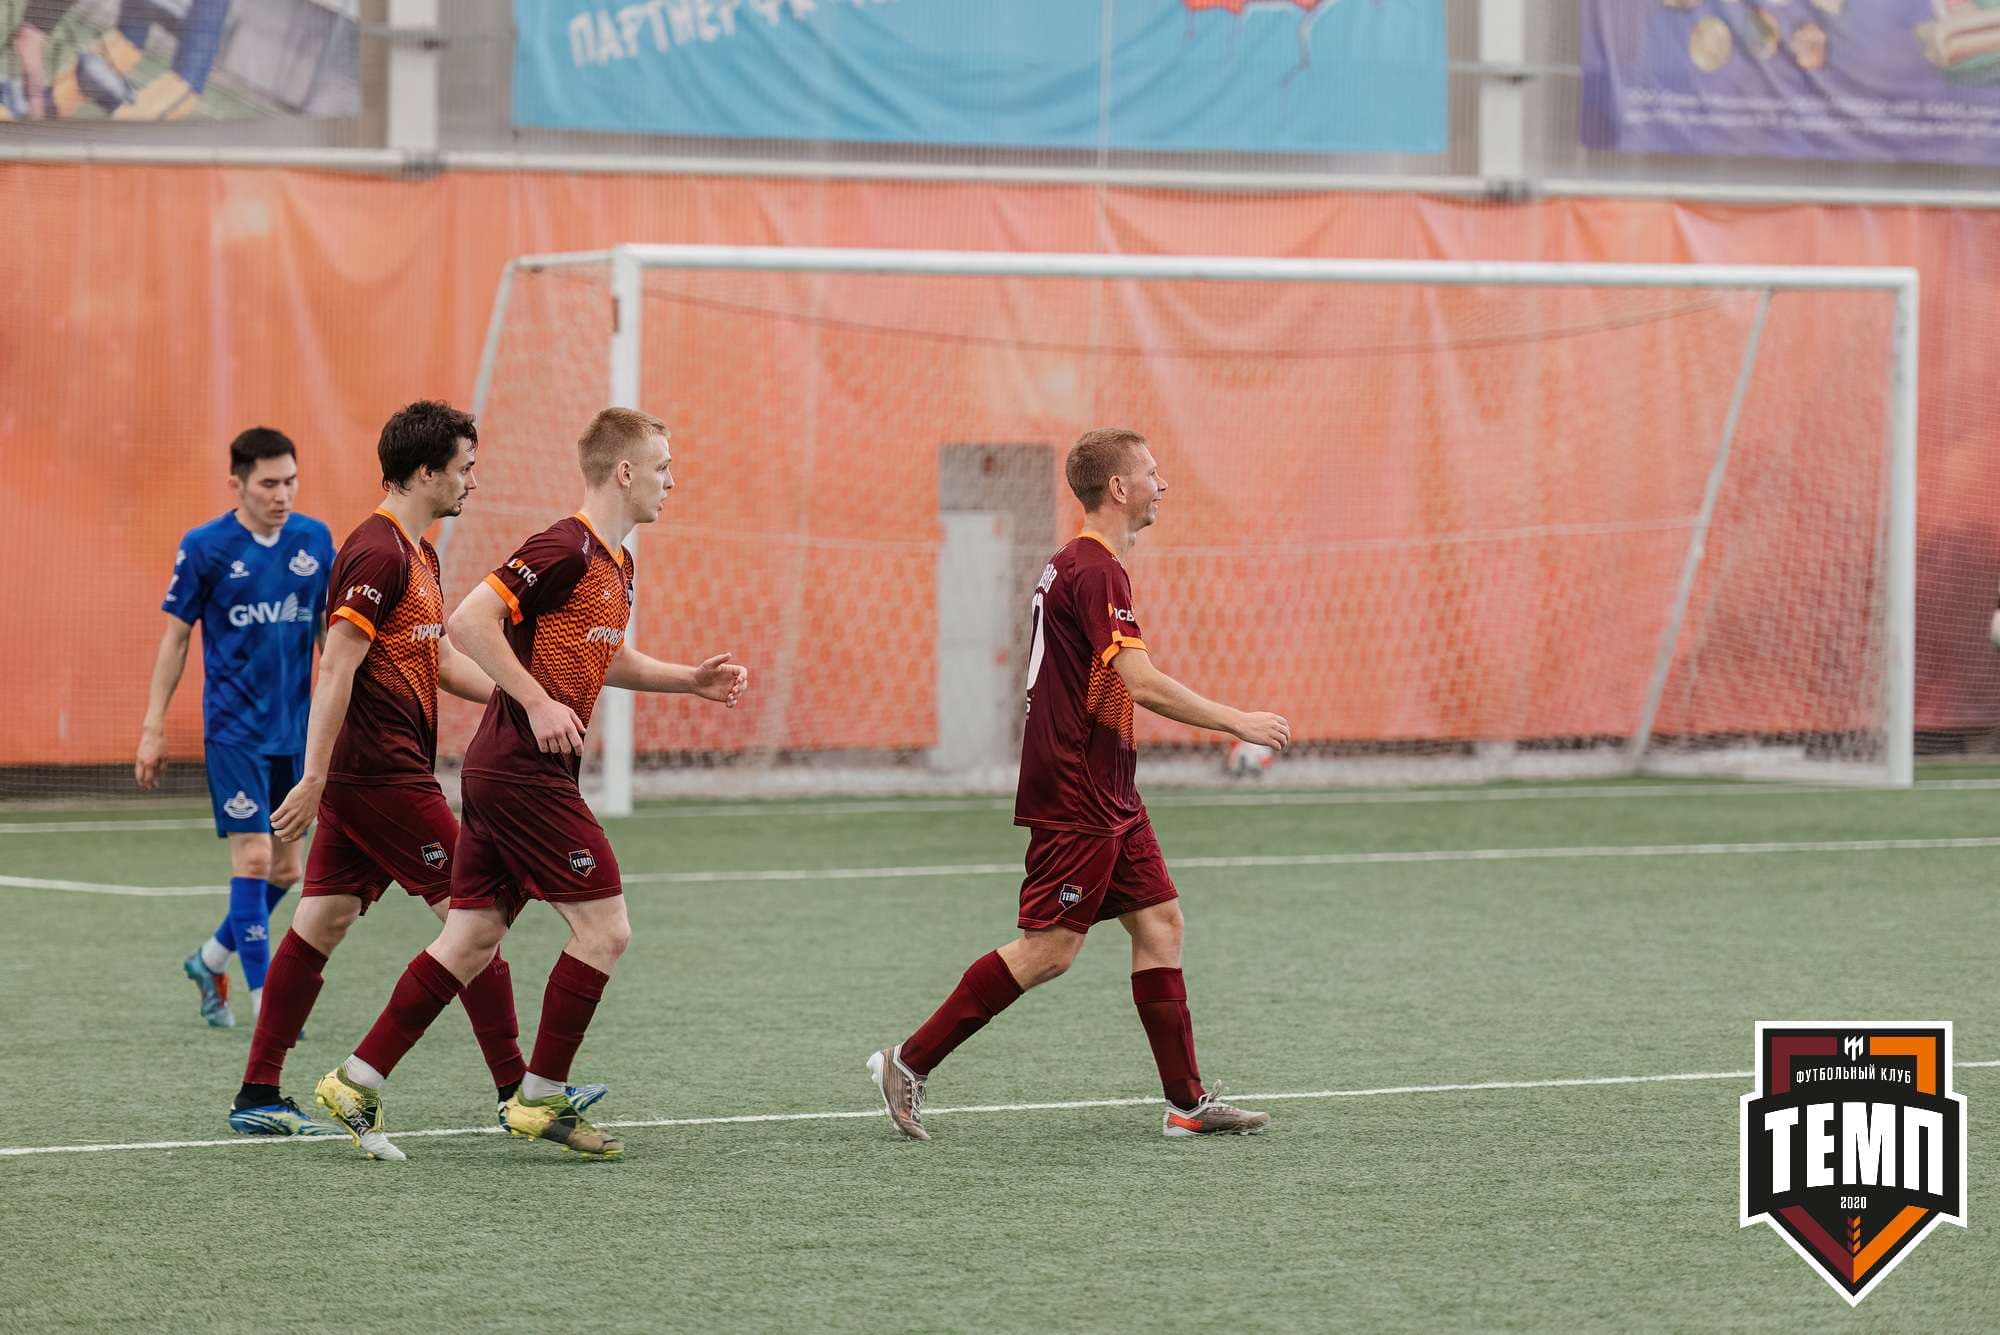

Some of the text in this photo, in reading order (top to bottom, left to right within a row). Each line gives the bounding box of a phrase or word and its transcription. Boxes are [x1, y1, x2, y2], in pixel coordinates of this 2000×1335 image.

[229, 600, 282, 627] GNV
[425, 850, 444, 861] ТЕМП
[573, 857, 593, 868] ТЕМП
[1062, 892, 1080, 902] ТЕМП
